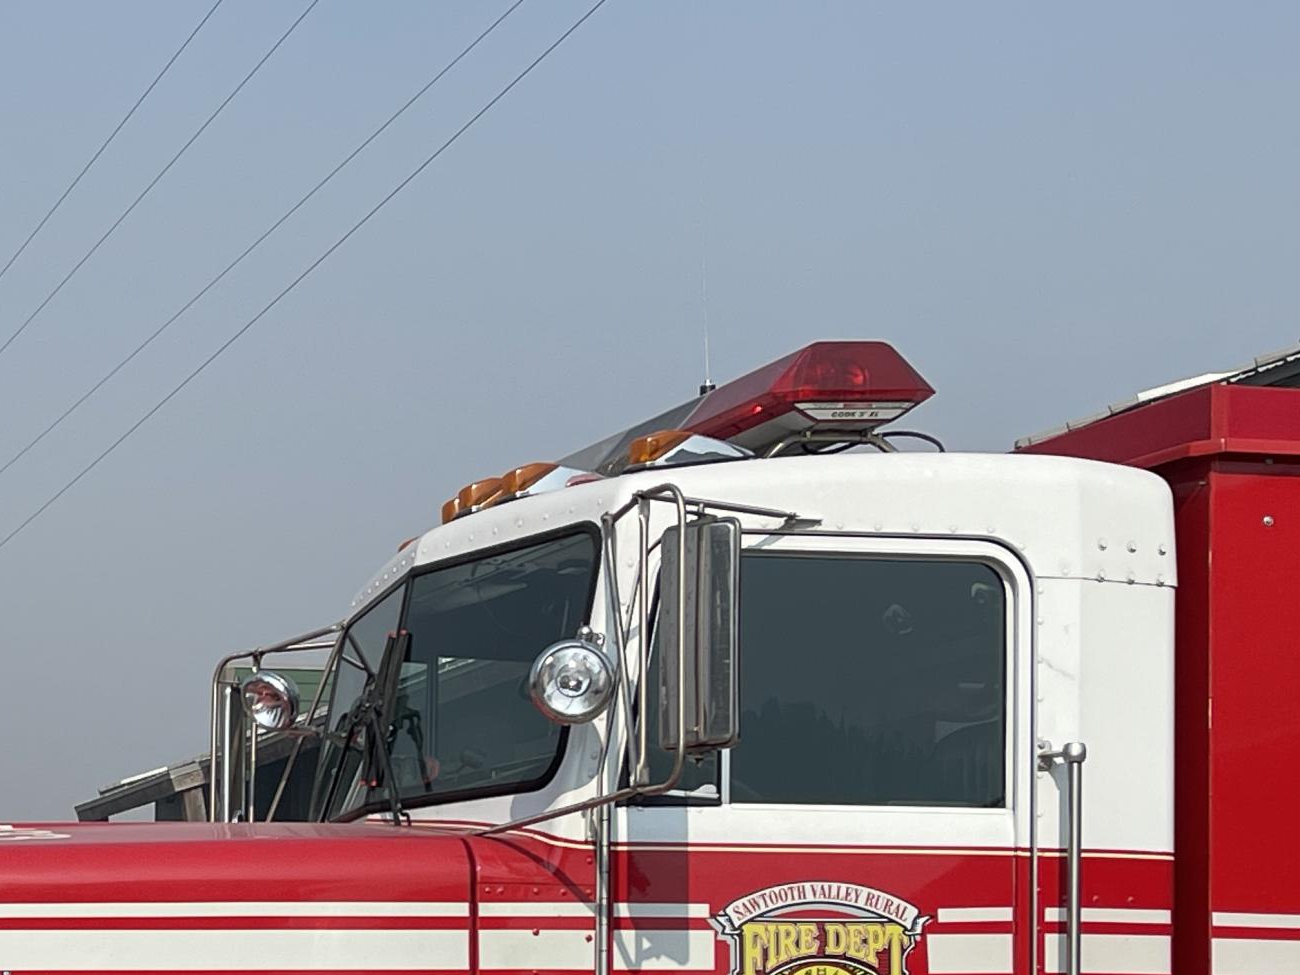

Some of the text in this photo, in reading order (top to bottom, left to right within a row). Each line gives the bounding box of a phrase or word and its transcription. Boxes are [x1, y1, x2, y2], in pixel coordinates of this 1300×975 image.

[732, 883, 909, 922] SAWTOOTH VALLEY RURAL
